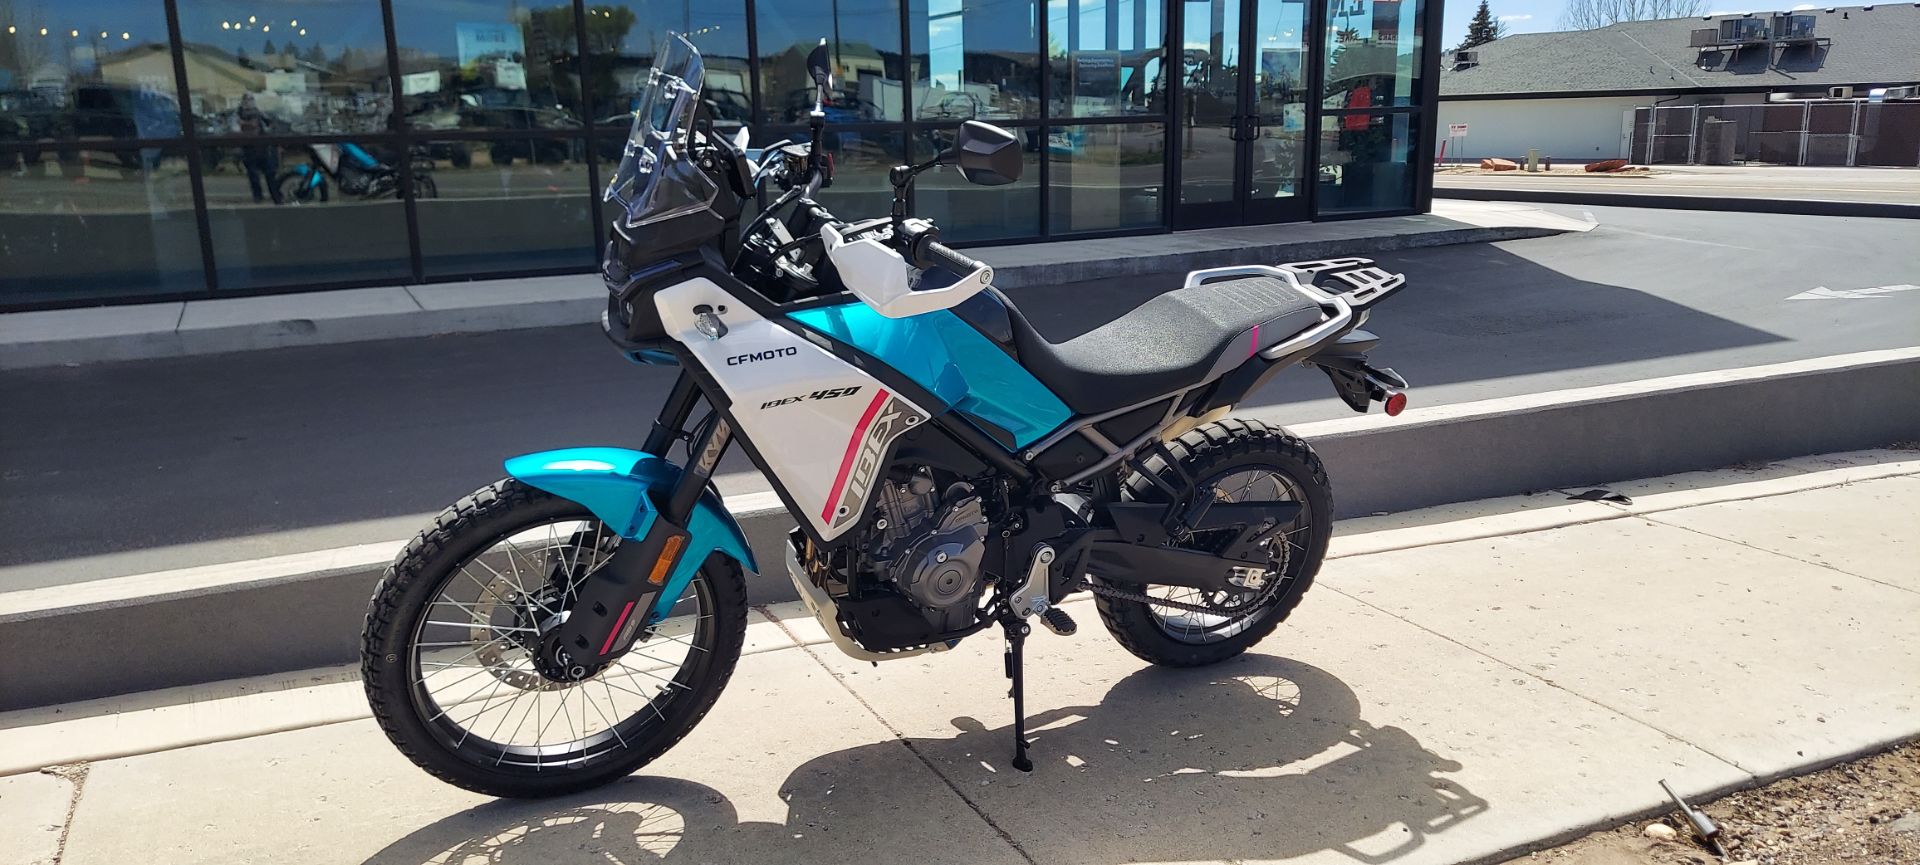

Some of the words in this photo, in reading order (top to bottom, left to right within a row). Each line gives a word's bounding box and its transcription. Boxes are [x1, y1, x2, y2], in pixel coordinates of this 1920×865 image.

[727, 346, 797, 366] CFMOTO
[760, 395, 807, 410] IBEX
[809, 385, 862, 400] 450
[851, 401, 902, 499] IBEX
